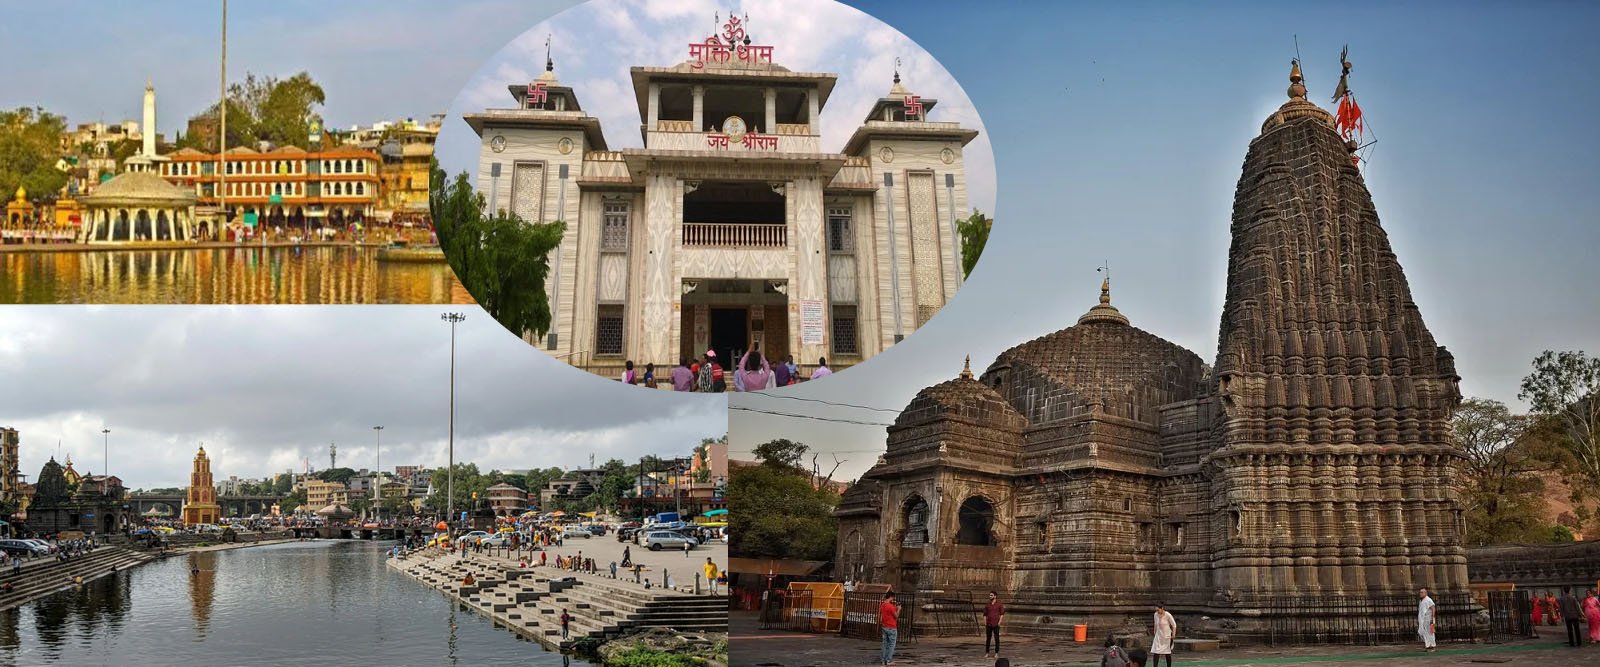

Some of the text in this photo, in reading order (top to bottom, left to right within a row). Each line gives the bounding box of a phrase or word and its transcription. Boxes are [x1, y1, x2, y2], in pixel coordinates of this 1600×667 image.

[688, 36, 774, 69] मुक्ति धाम
[707, 131, 778, 152] जय श्रीराम
